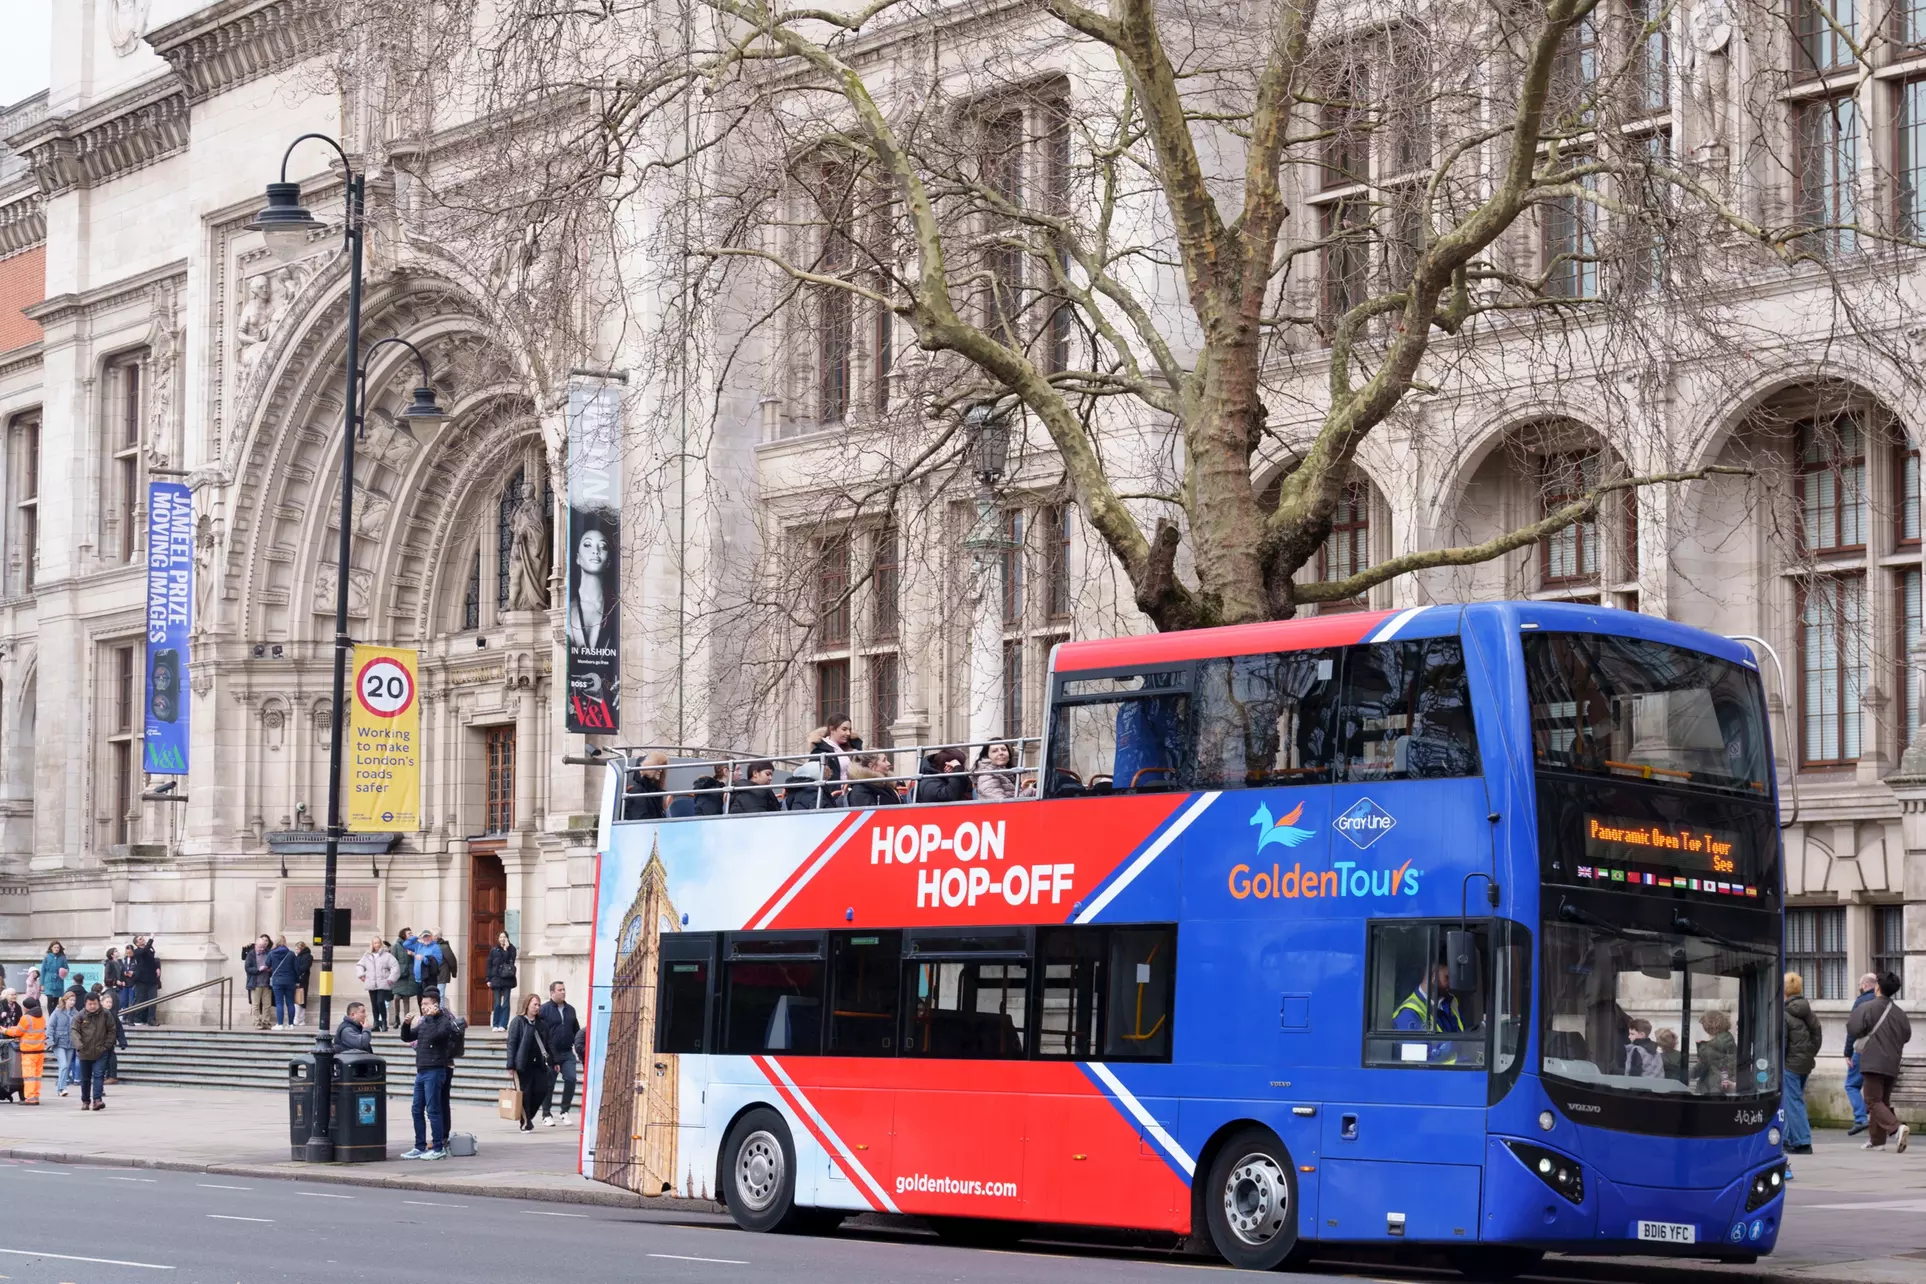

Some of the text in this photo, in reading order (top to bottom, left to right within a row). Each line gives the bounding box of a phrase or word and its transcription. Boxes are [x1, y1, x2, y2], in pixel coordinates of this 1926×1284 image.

[149, 491, 172, 644] MOVING IMAGES
[168, 492, 191, 627] JAMEEL PRIZE
[571, 646, 617, 657] IN FASHION
[367, 675, 404, 699] 20
[570, 680, 588, 688] BOSS
[571, 696, 616, 729] V&A
[357, 727, 411, 741] Working
[147, 742, 186, 769] V&A
[356, 742, 410, 752] to make
[356, 754, 415, 767] London's
[356, 769, 393, 779] roads
[355, 782, 389, 793] safer
[870, 820, 1006, 865] HOP-ON
[1591, 819, 1732, 856] Panoramic Open Top Tour
[1712, 854, 1734, 872] See
[917, 863, 1075, 908] HOP-OFF
[1567, 1102, 1602, 1113] VOLVO
[895, 1173, 1017, 1197] goldentours.com
[1643, 1223, 1689, 1241] BD16 YFC
